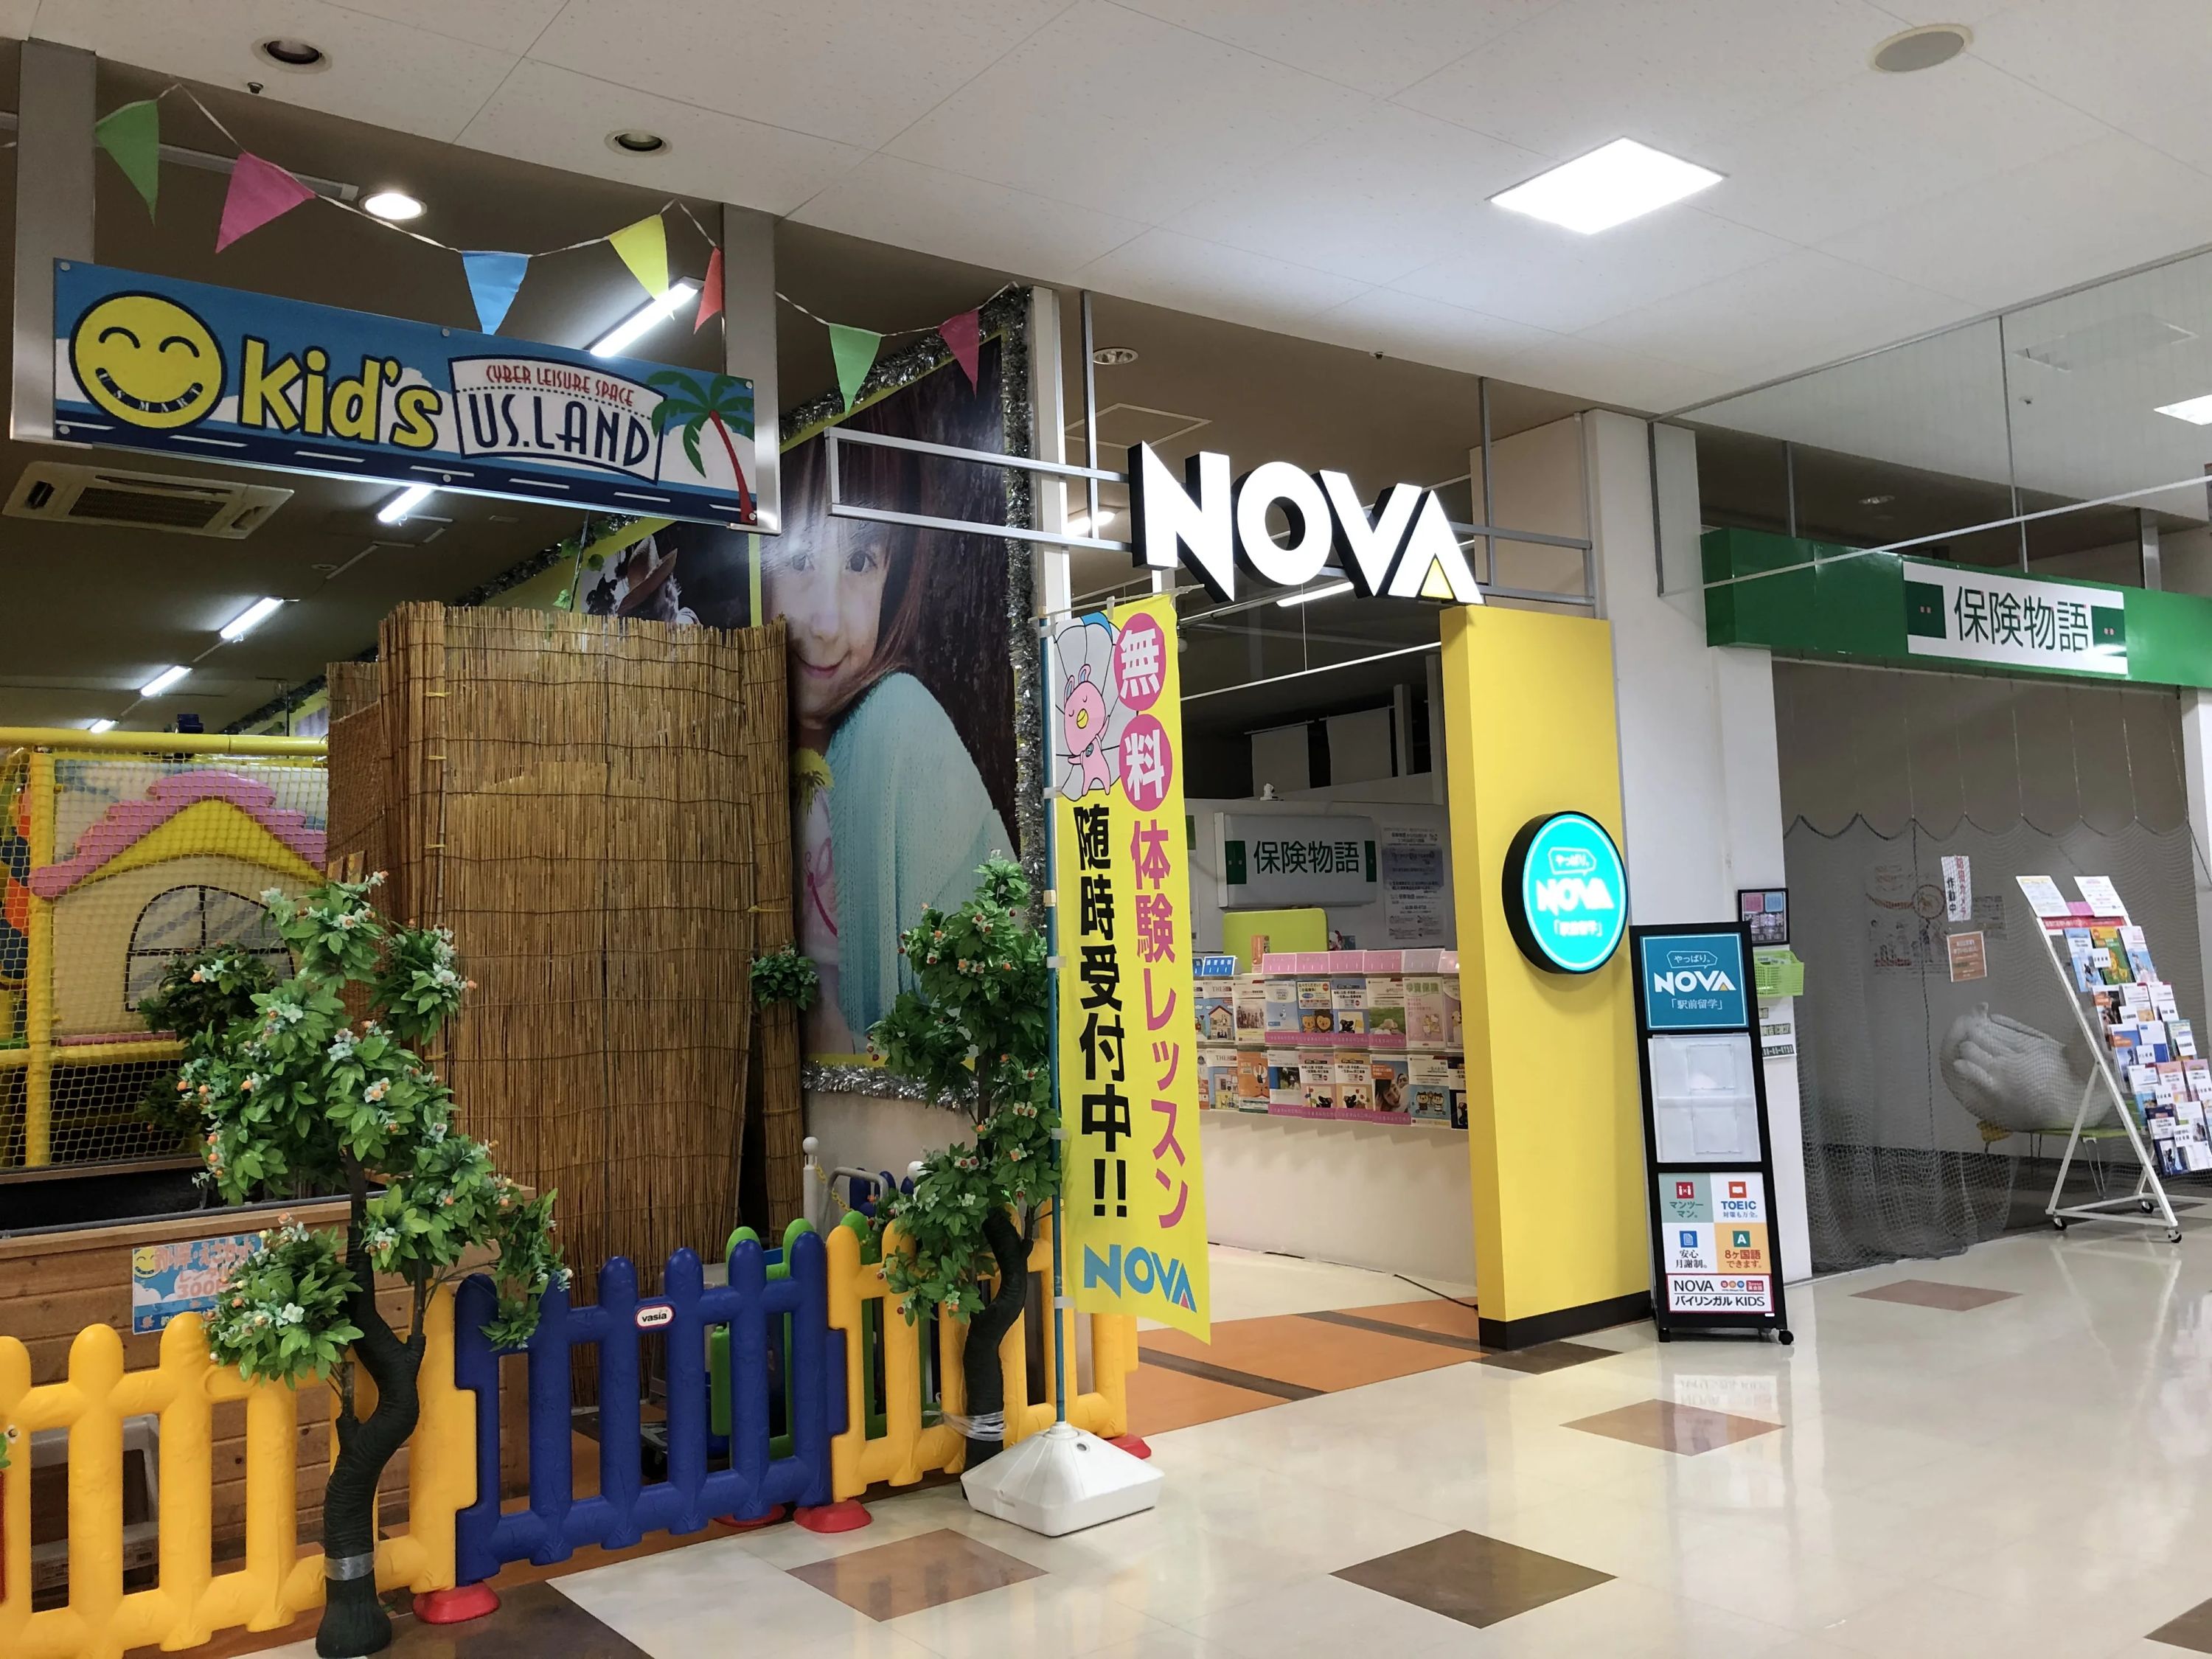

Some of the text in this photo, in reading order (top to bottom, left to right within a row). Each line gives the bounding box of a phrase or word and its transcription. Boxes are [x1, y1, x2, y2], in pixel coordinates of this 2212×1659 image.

[486, 365, 635, 406] CYBER LEISURE SPACE
[240, 335, 442, 450] Kid's
[1130, 441, 1484, 604] NOVA
[1954, 586, 2089, 653] 保険物語
[1253, 840, 1360, 874] 保険物語
[1535, 877, 1615, 916] NOVA
[1654, 970, 1736, 996] NOVA
[1669, 1201, 1704, 1209] マンツー
[1721, 1200, 1757, 1210] TOEIC
[1677, 1210, 1698, 1218] マン。
[1679, 1249, 1699, 1259] 安心
[1675, 1259, 1708, 1268] 月謝制。
[1727, 1260, 1762, 1269] できます。
[1084, 1243, 1197, 1313] NOVA
[1674, 1280, 1714, 1292] NOVA
[1674, 1295, 1765, 1307] バイリンガル KIDS
[642, 1312, 667, 1322] vasia
